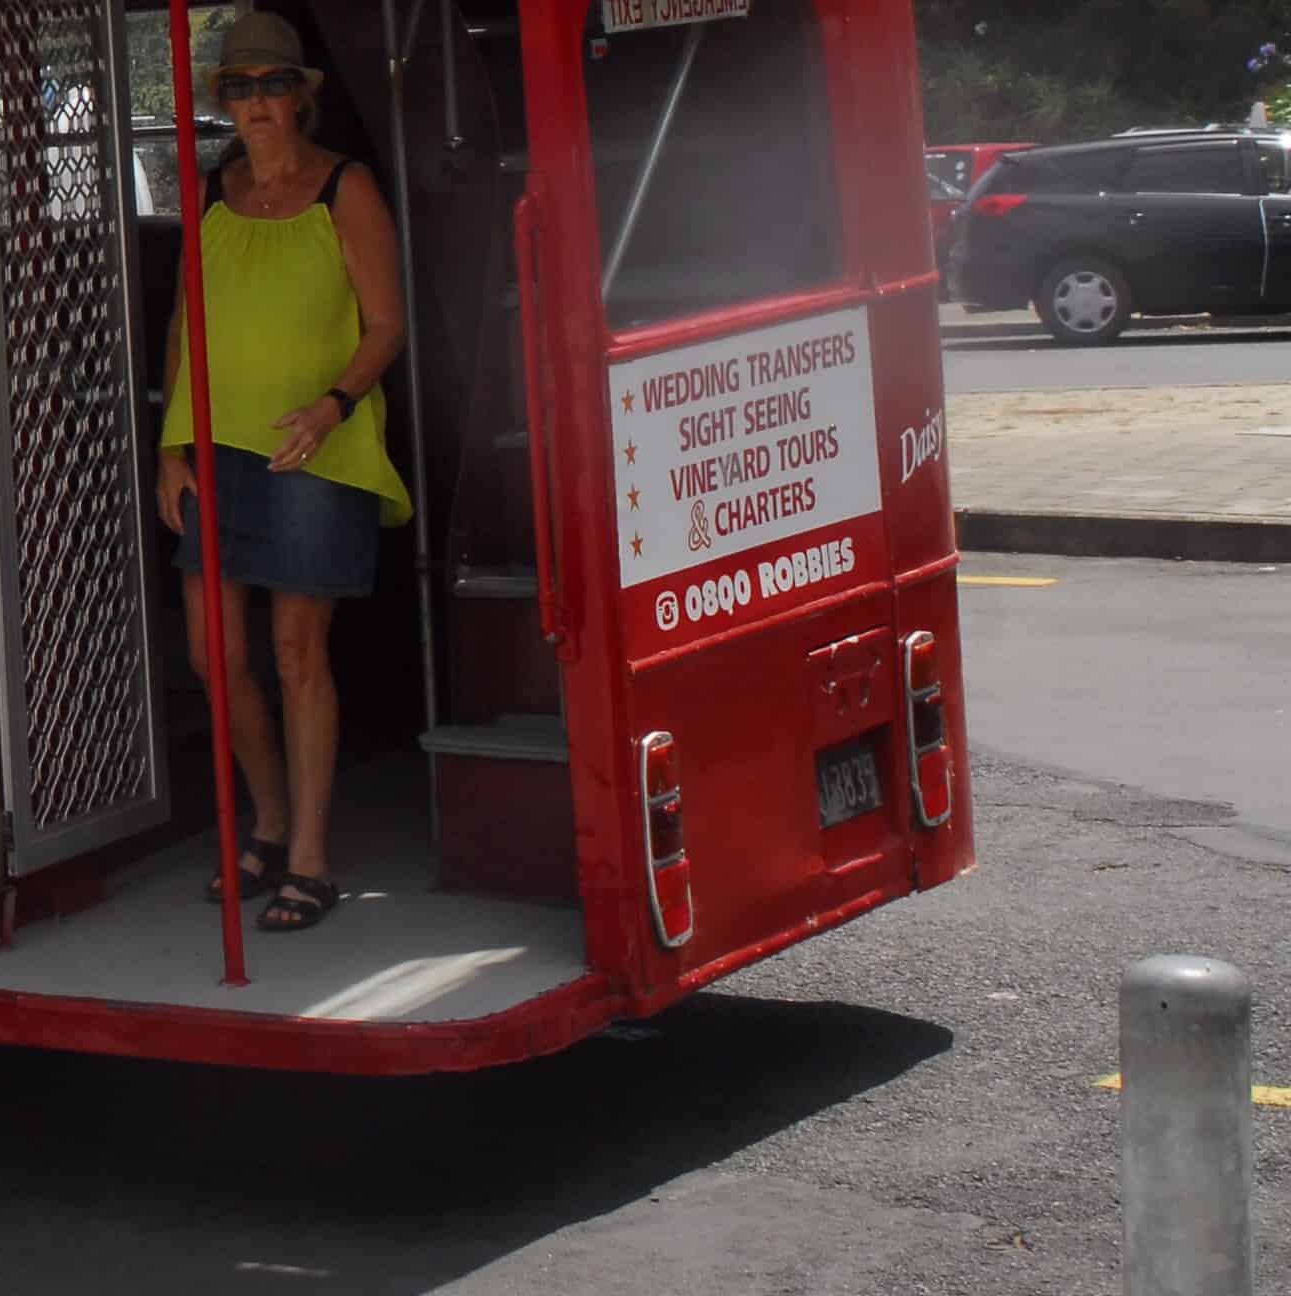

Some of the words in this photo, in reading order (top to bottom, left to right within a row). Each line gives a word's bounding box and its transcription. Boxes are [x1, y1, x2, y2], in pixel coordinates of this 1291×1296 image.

[642, 358, 740, 413] WEDDING
[747, 331, 856, 386] TRANSFERS
[679, 407, 736, 453] SIGHT
[744, 387, 811, 436] SEEING
[670, 447, 770, 501] VINEYARD
[776, 424, 839, 472] TOURS
[687, 499, 712, 552] &
[714, 477, 816, 536] CHARTERS
[757, 537, 855, 598] ROBBIES
